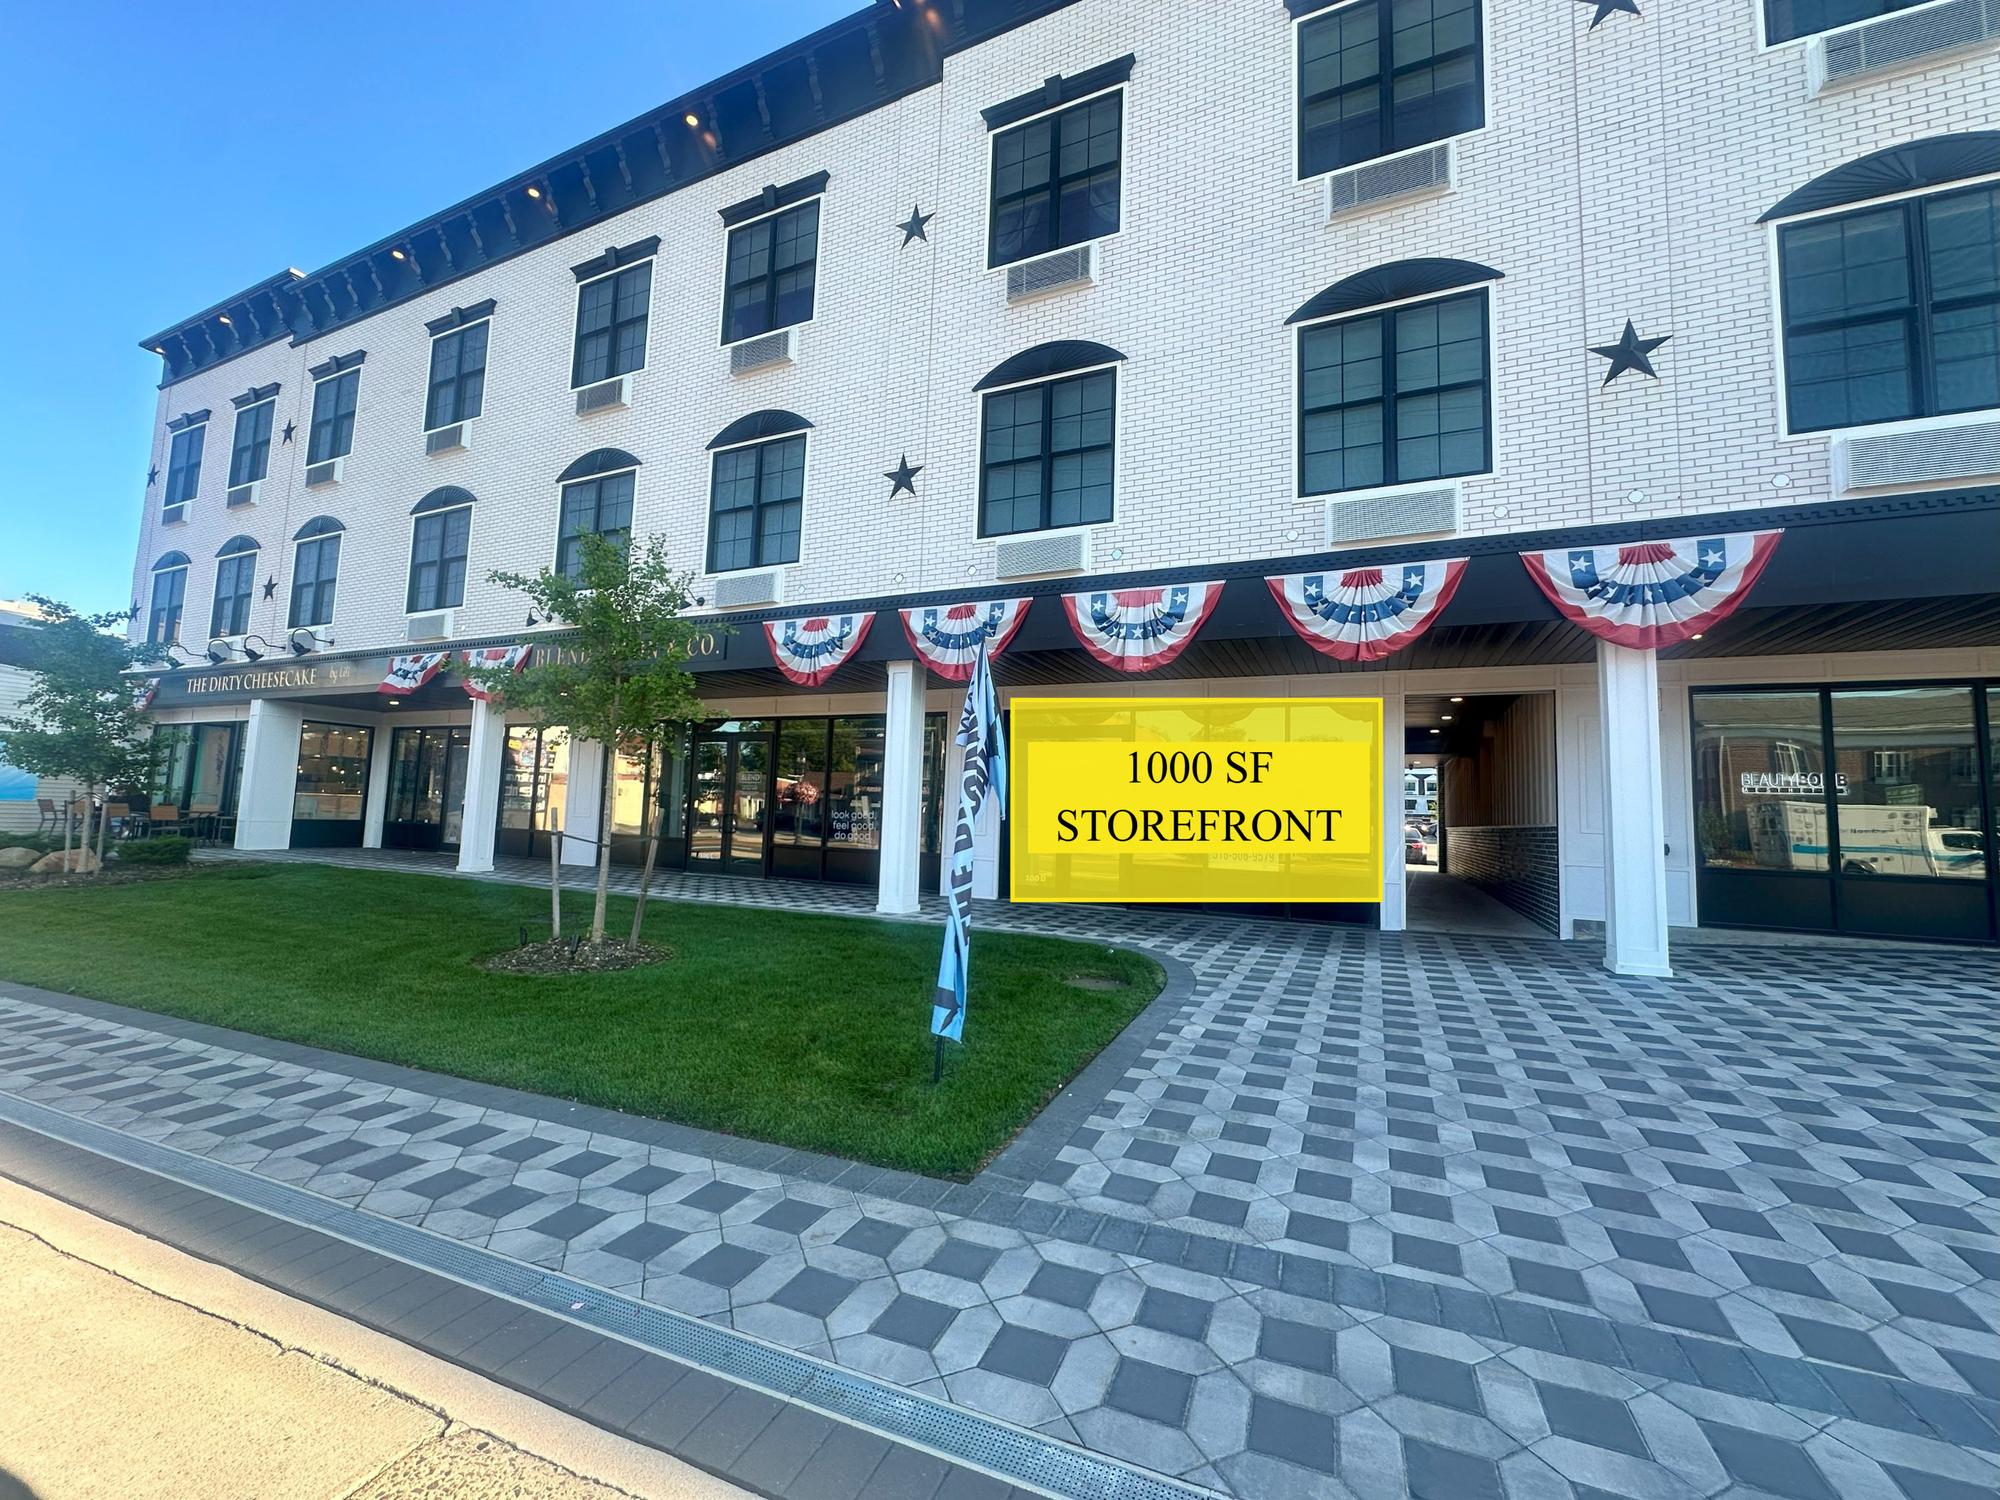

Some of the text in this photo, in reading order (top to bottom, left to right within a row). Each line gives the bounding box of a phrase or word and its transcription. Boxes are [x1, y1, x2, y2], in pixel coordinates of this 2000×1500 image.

[687, 633, 720, 657] CO.
[187, 678, 207, 694] THE
[208, 675, 243, 692] DIRTY
[243, 668, 317, 690] CHEESECAKE
[1741, 772, 1848, 787] BEAUTYBOB
[831, 810, 849, 819] look
[833, 820, 849, 830] feel
[834, 831, 846, 840] do
